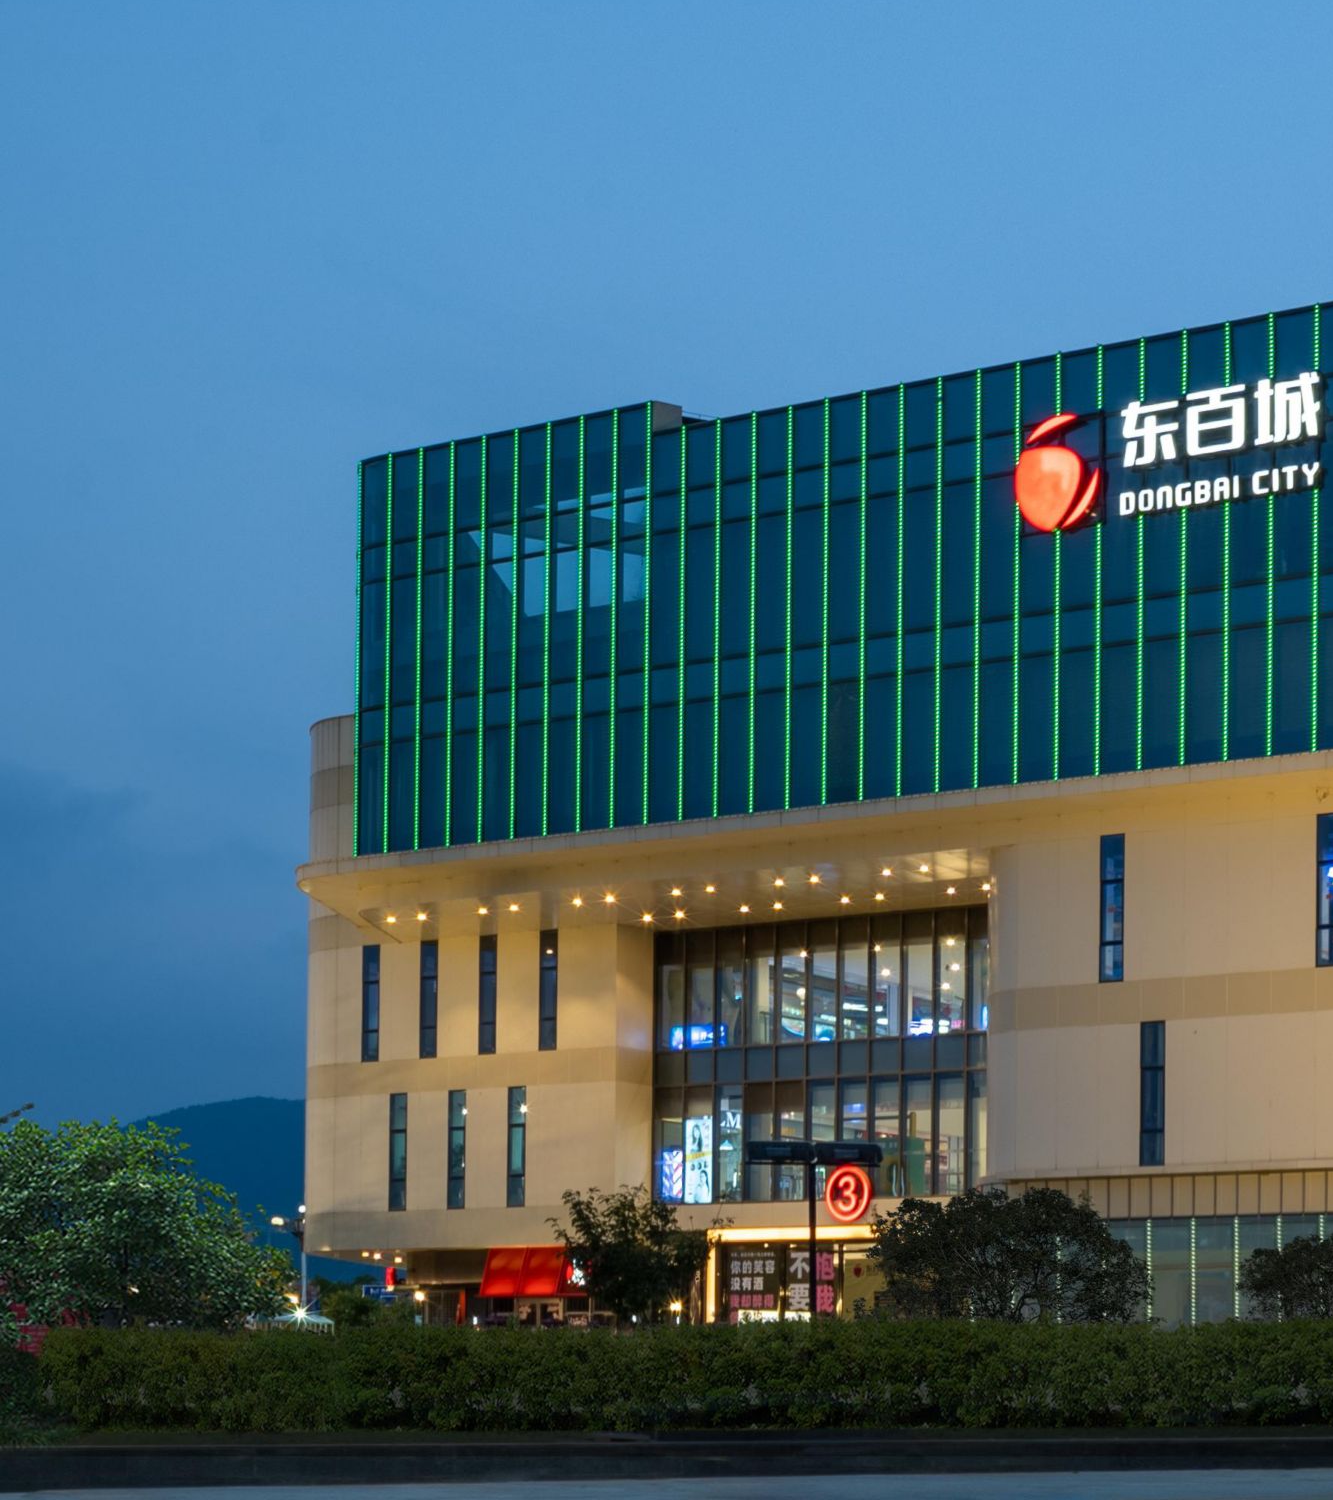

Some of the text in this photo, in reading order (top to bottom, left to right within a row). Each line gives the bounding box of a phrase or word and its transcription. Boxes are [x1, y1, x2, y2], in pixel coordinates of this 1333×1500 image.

[1120, 370, 1321, 468] 东百城
[1119, 461, 1321, 517] DONGBAI CITY
